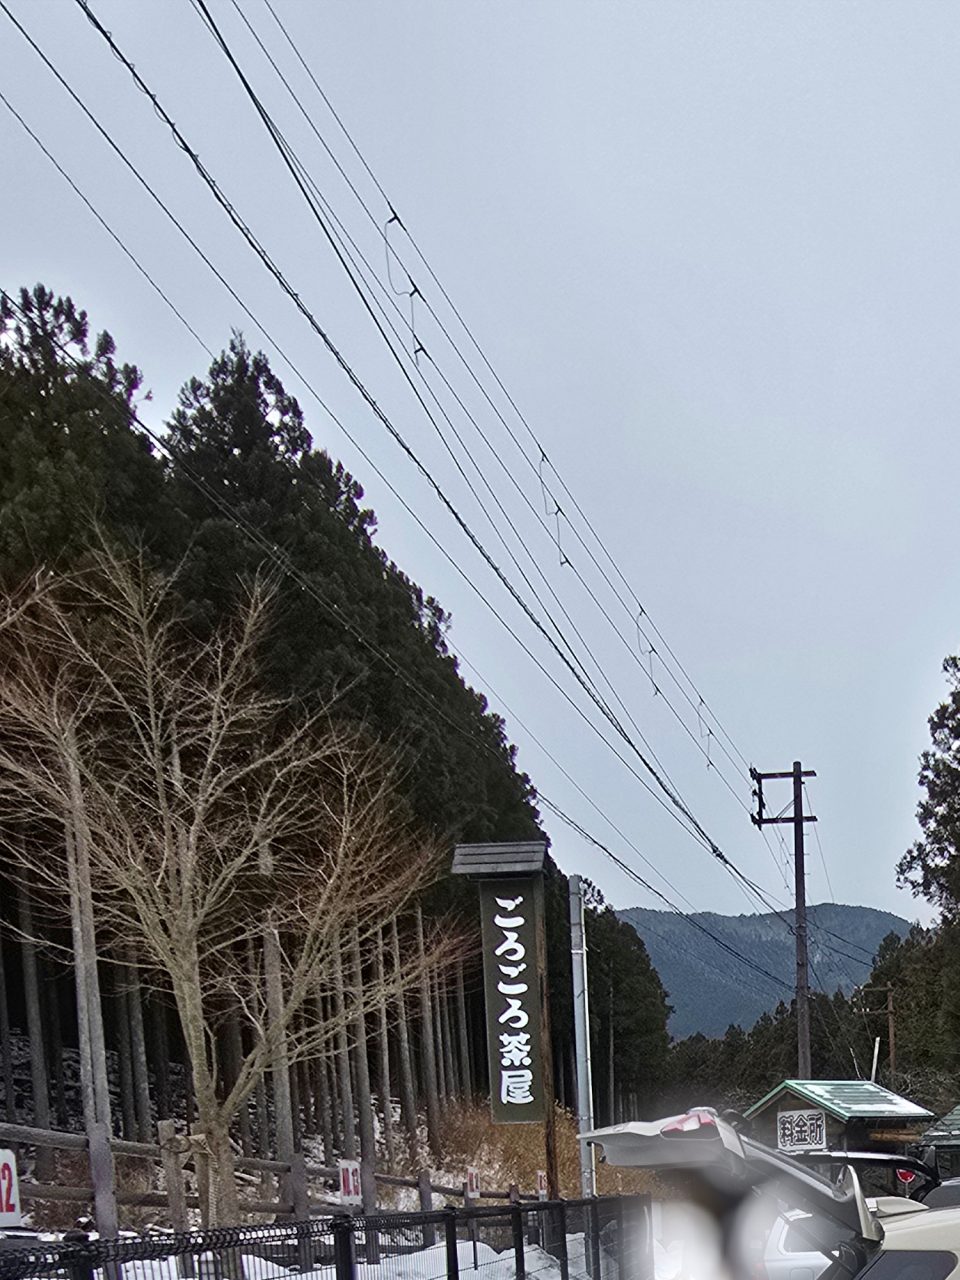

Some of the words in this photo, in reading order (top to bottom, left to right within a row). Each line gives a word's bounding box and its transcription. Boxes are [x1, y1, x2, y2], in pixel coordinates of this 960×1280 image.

[494, 896, 535, 1105] ごろごろ茶屋
[779, 1112, 824, 1147] 料金所
